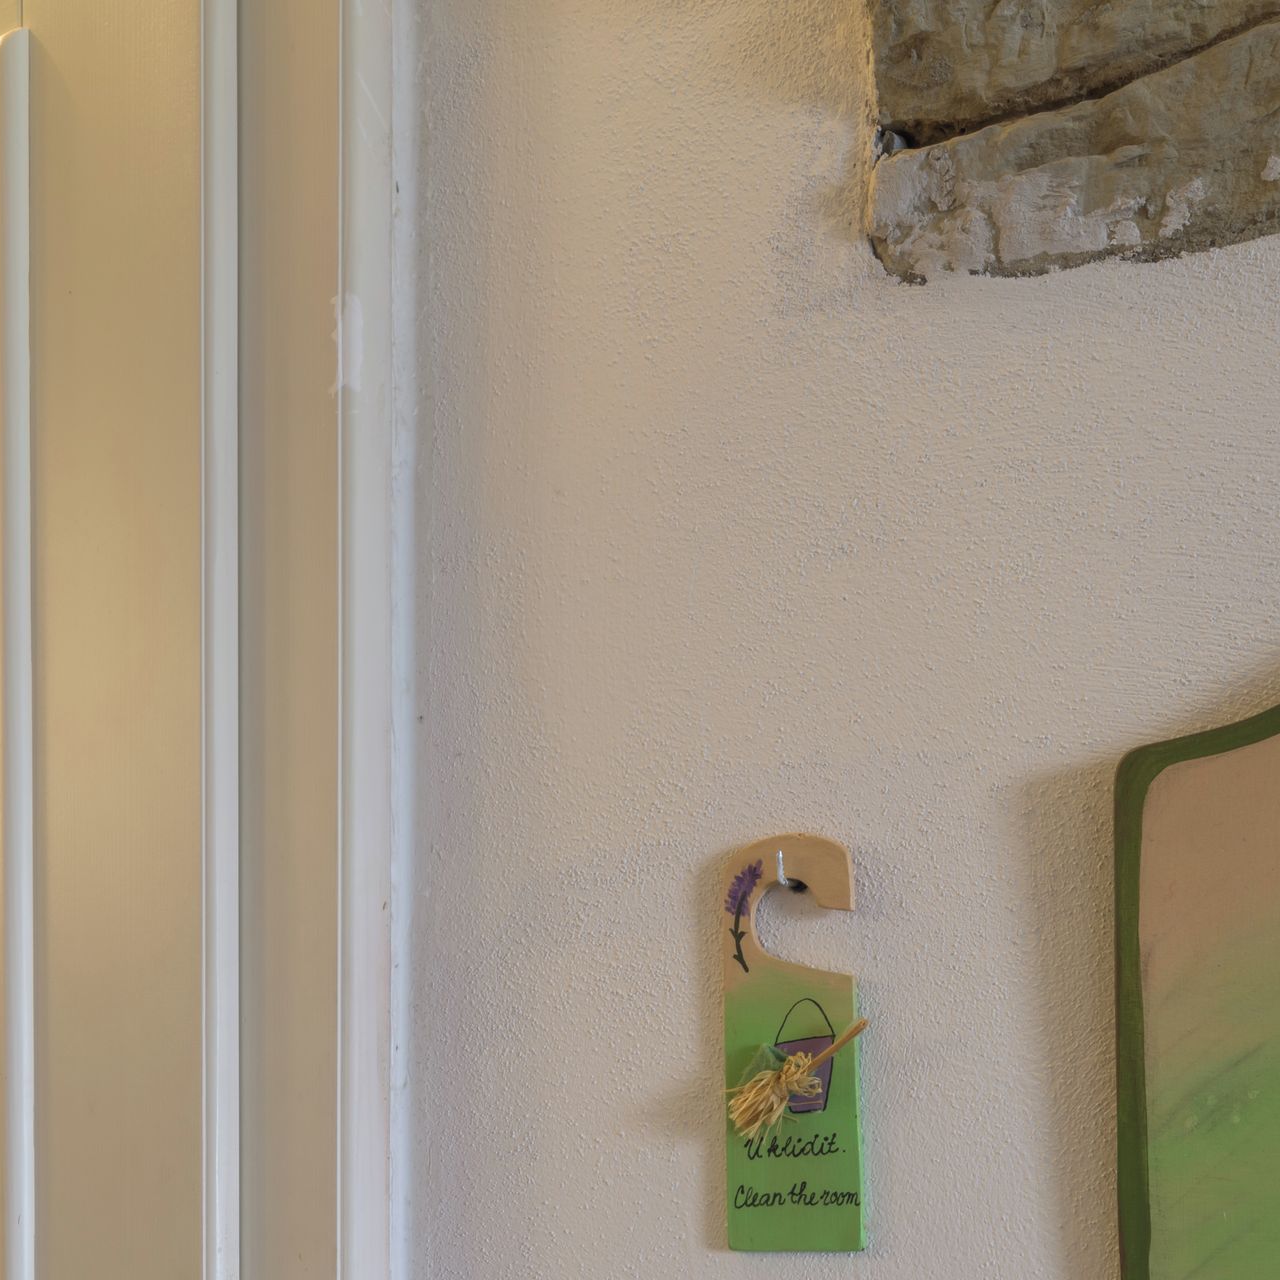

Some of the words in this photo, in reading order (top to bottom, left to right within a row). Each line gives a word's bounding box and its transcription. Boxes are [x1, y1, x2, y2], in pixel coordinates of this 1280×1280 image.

[734, 1184, 786, 1209] Clean
[787, 1181, 819, 1206] the
[820, 1189, 861, 1207] room
